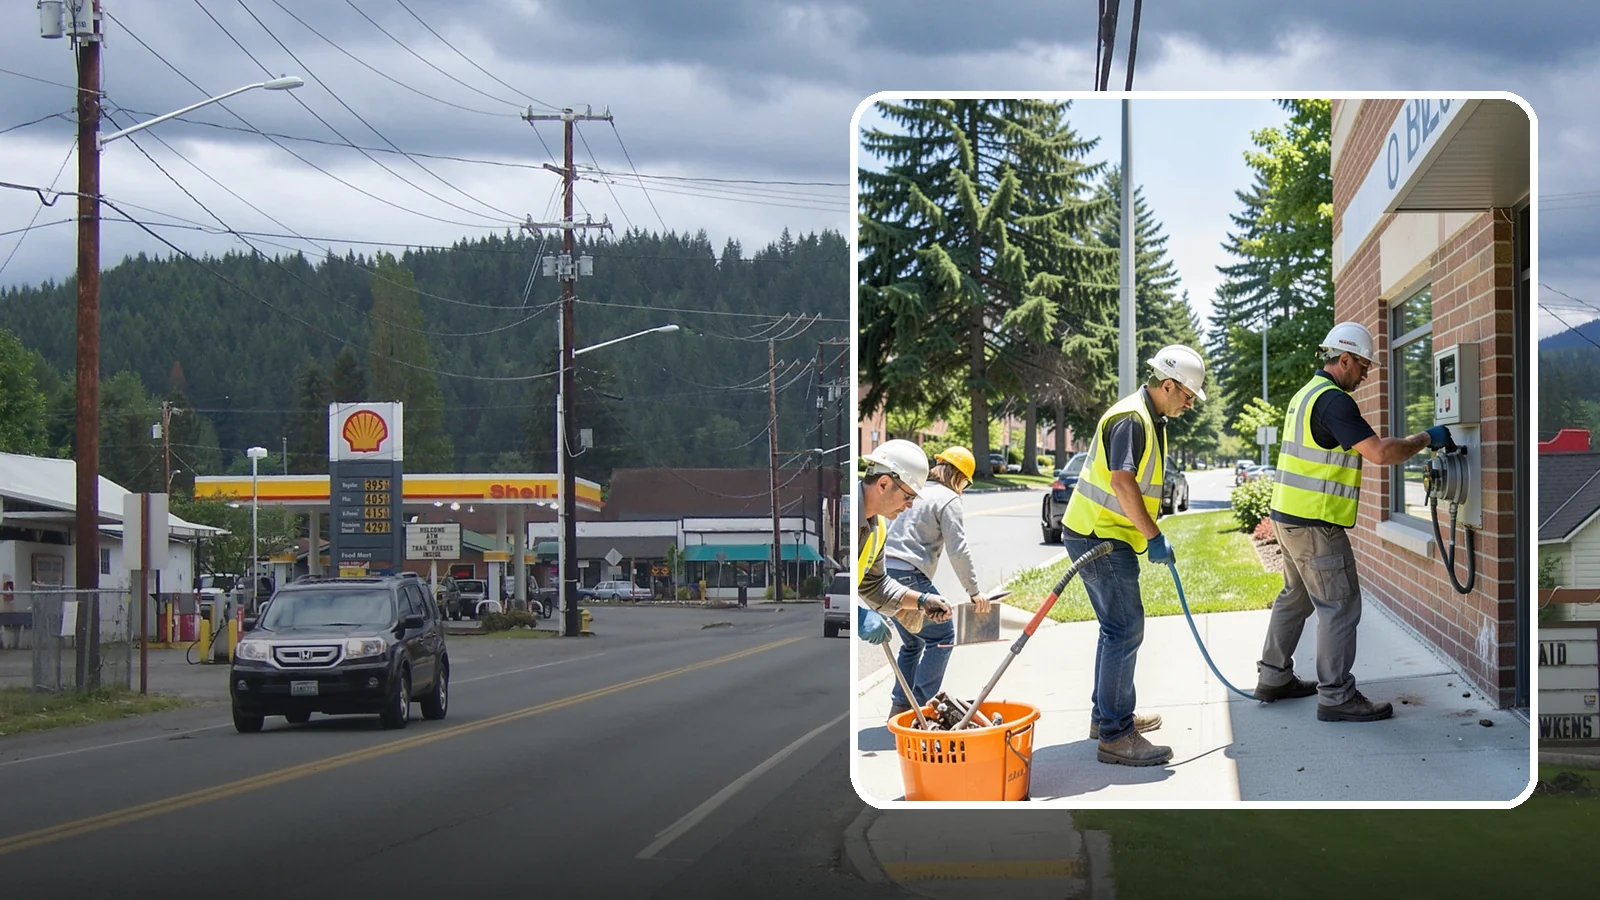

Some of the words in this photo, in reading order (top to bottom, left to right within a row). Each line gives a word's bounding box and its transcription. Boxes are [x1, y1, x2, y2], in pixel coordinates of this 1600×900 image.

[365, 480, 384, 490] 395
[490, 484, 547, 498] Shell
[365, 494, 384, 504] 405
[365, 508, 384, 518] 415
[365, 522, 384, 533] 429
